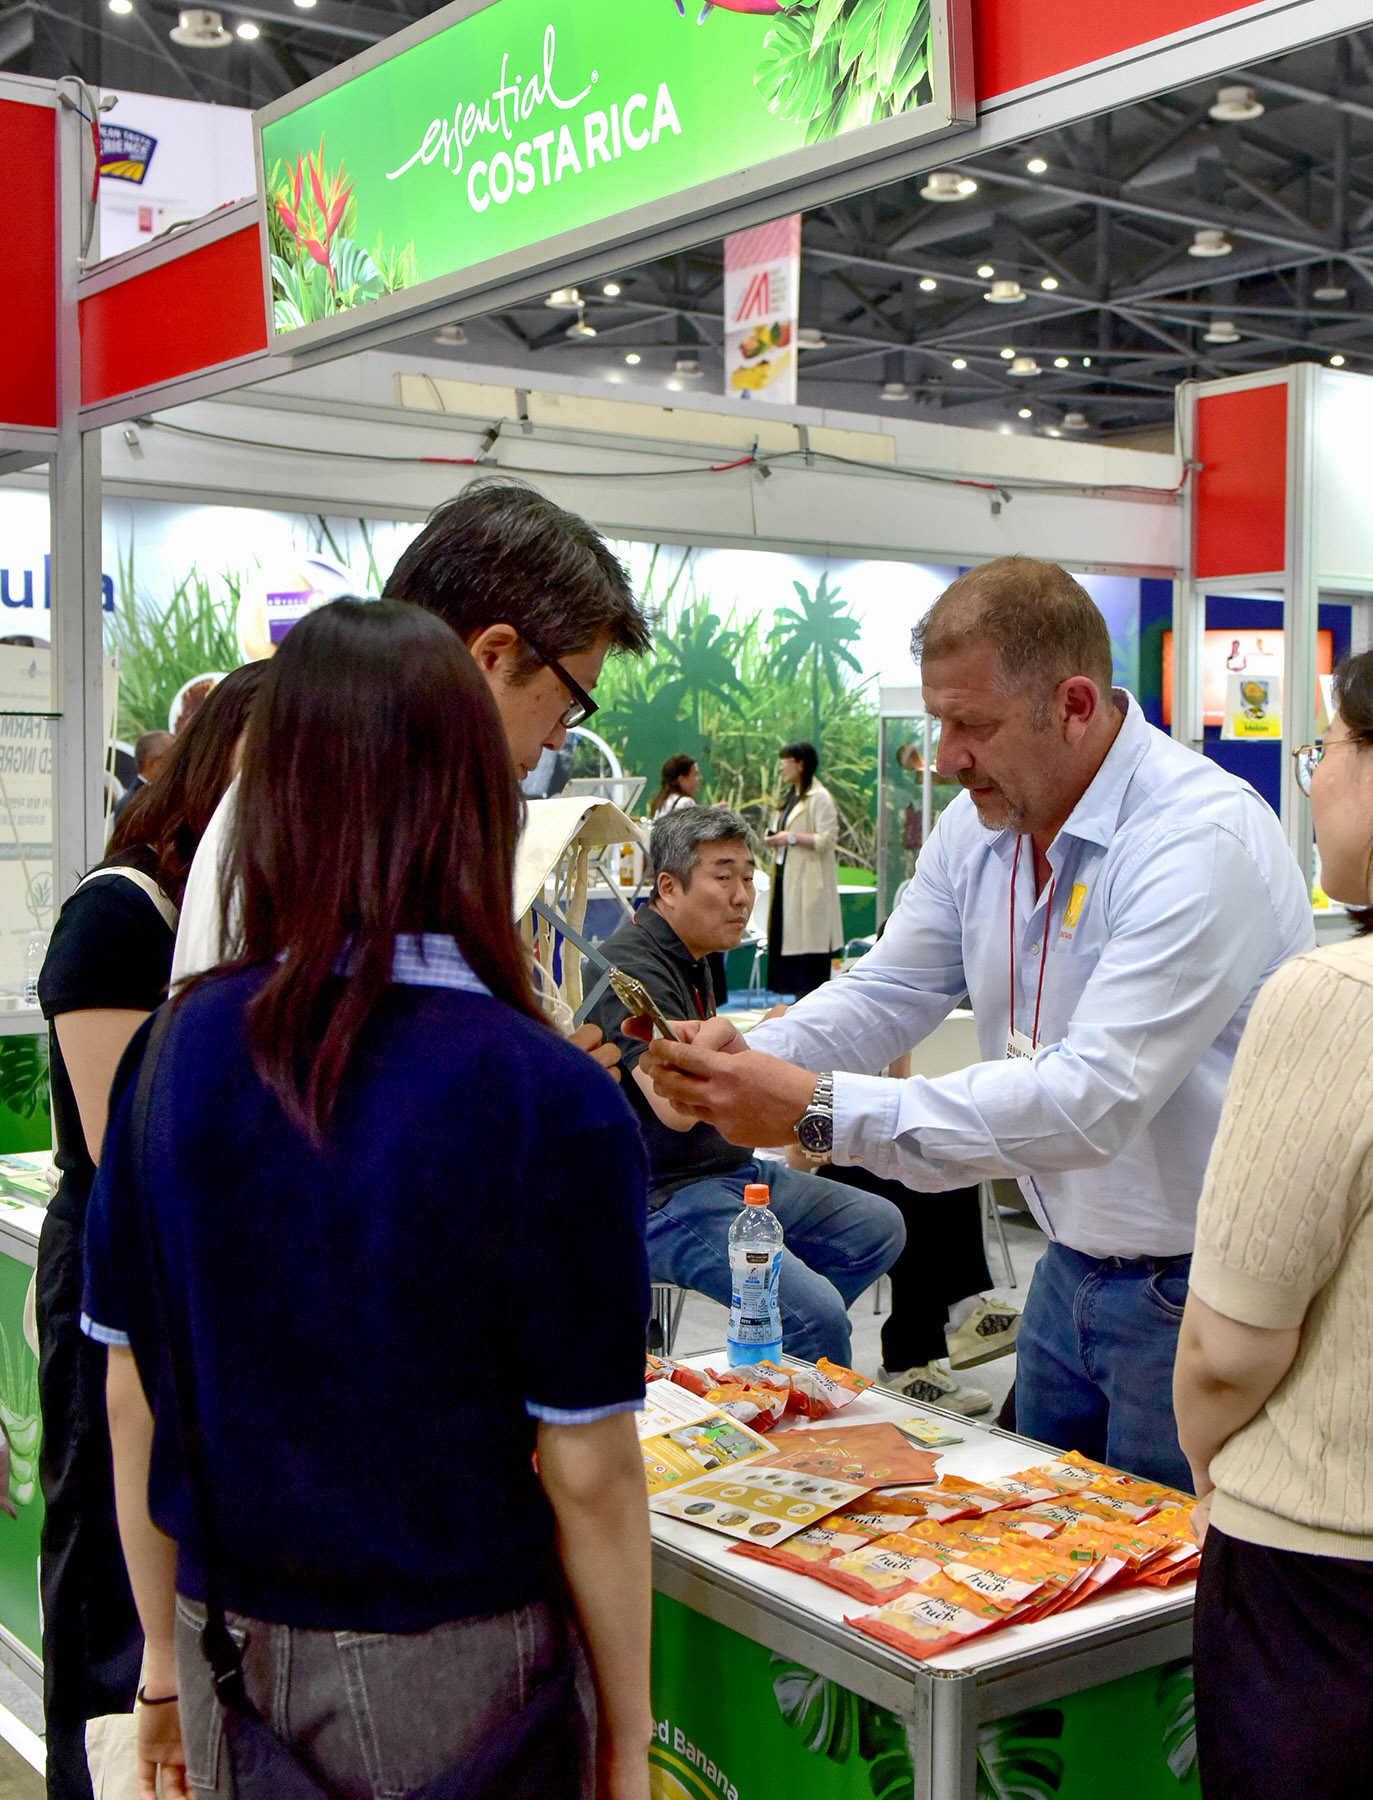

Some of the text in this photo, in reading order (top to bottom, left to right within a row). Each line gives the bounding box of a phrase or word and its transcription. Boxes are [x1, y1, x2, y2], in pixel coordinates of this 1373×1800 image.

[386, 24, 592, 180] essential
[467, 82, 682, 213] COSTA RICA
[674, 1726, 738, 1800] Banana
